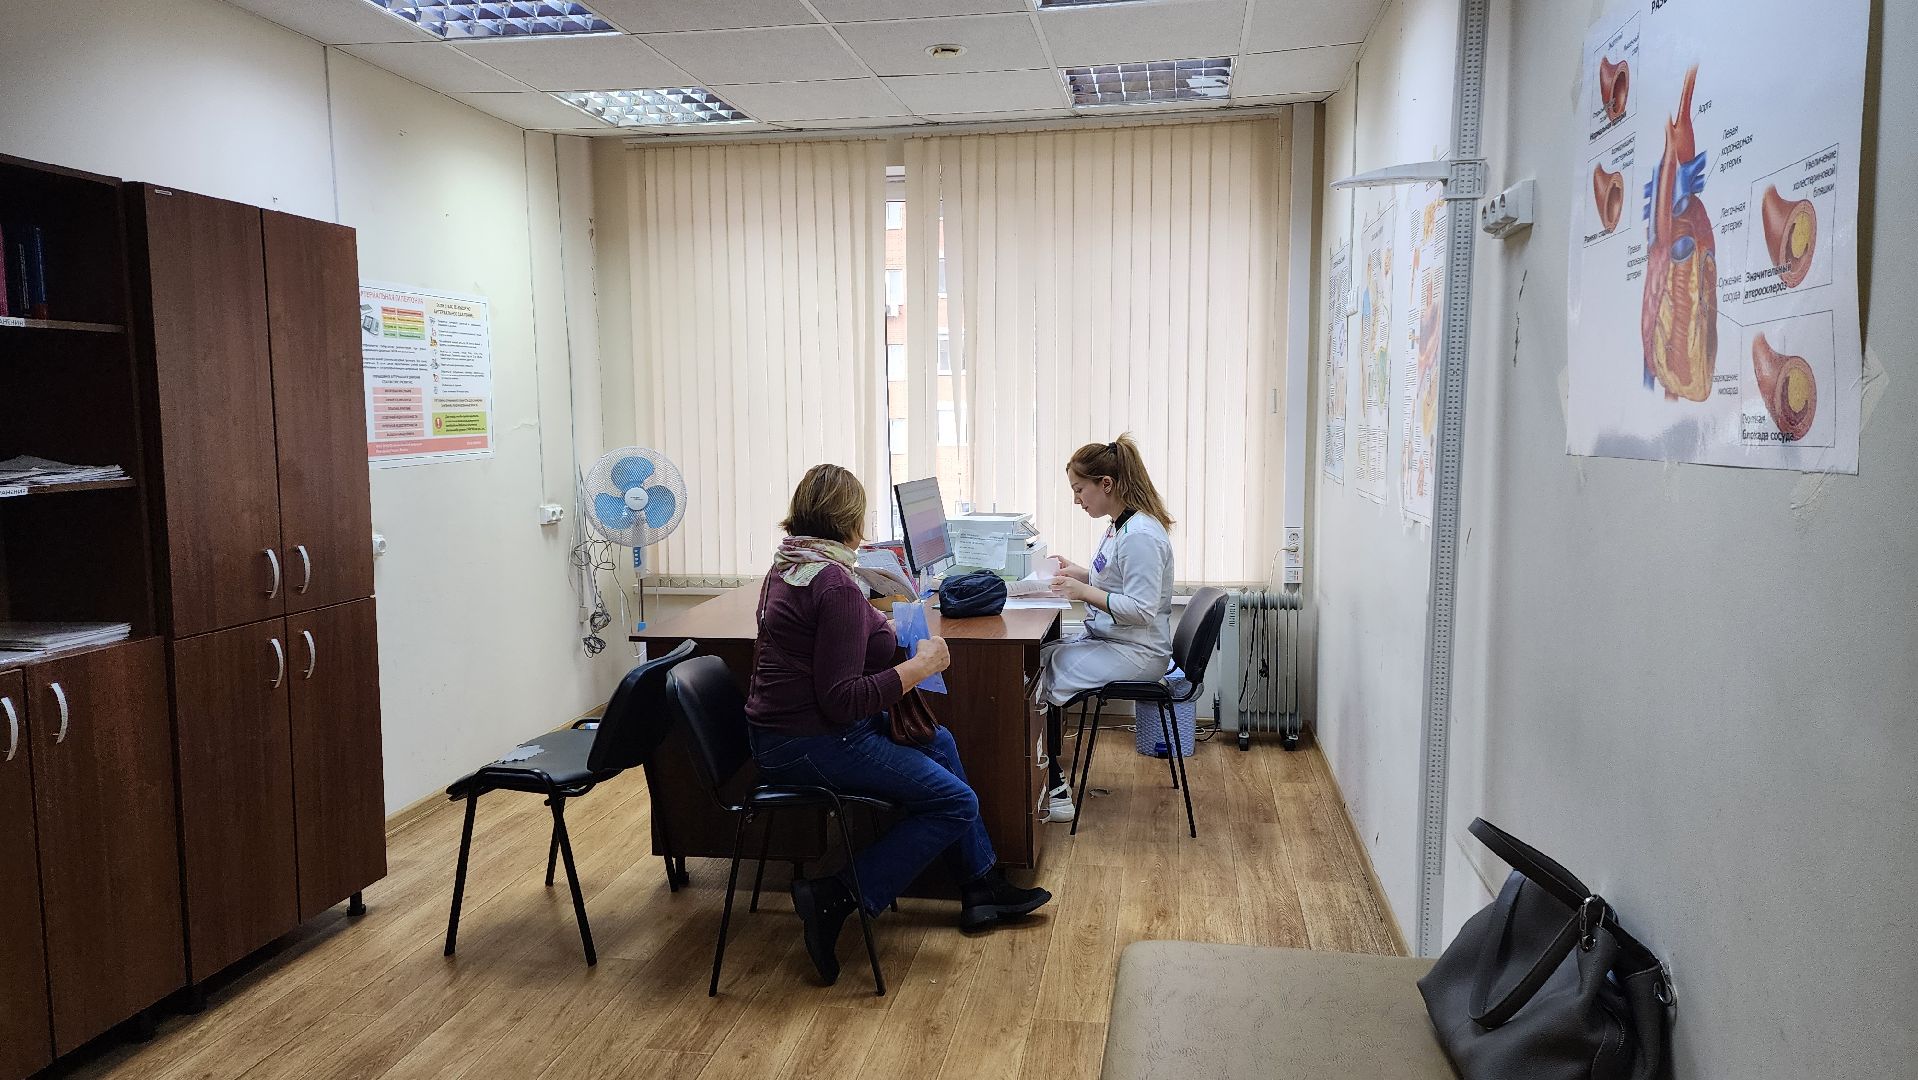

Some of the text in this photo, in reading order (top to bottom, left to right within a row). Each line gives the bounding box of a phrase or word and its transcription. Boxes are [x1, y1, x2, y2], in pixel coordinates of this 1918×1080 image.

[1744, 259, 1792, 283] Значительный
[1744, 281, 1788, 300] атеросклероз
[1742, 429, 1794, 443] блокада сосуда
